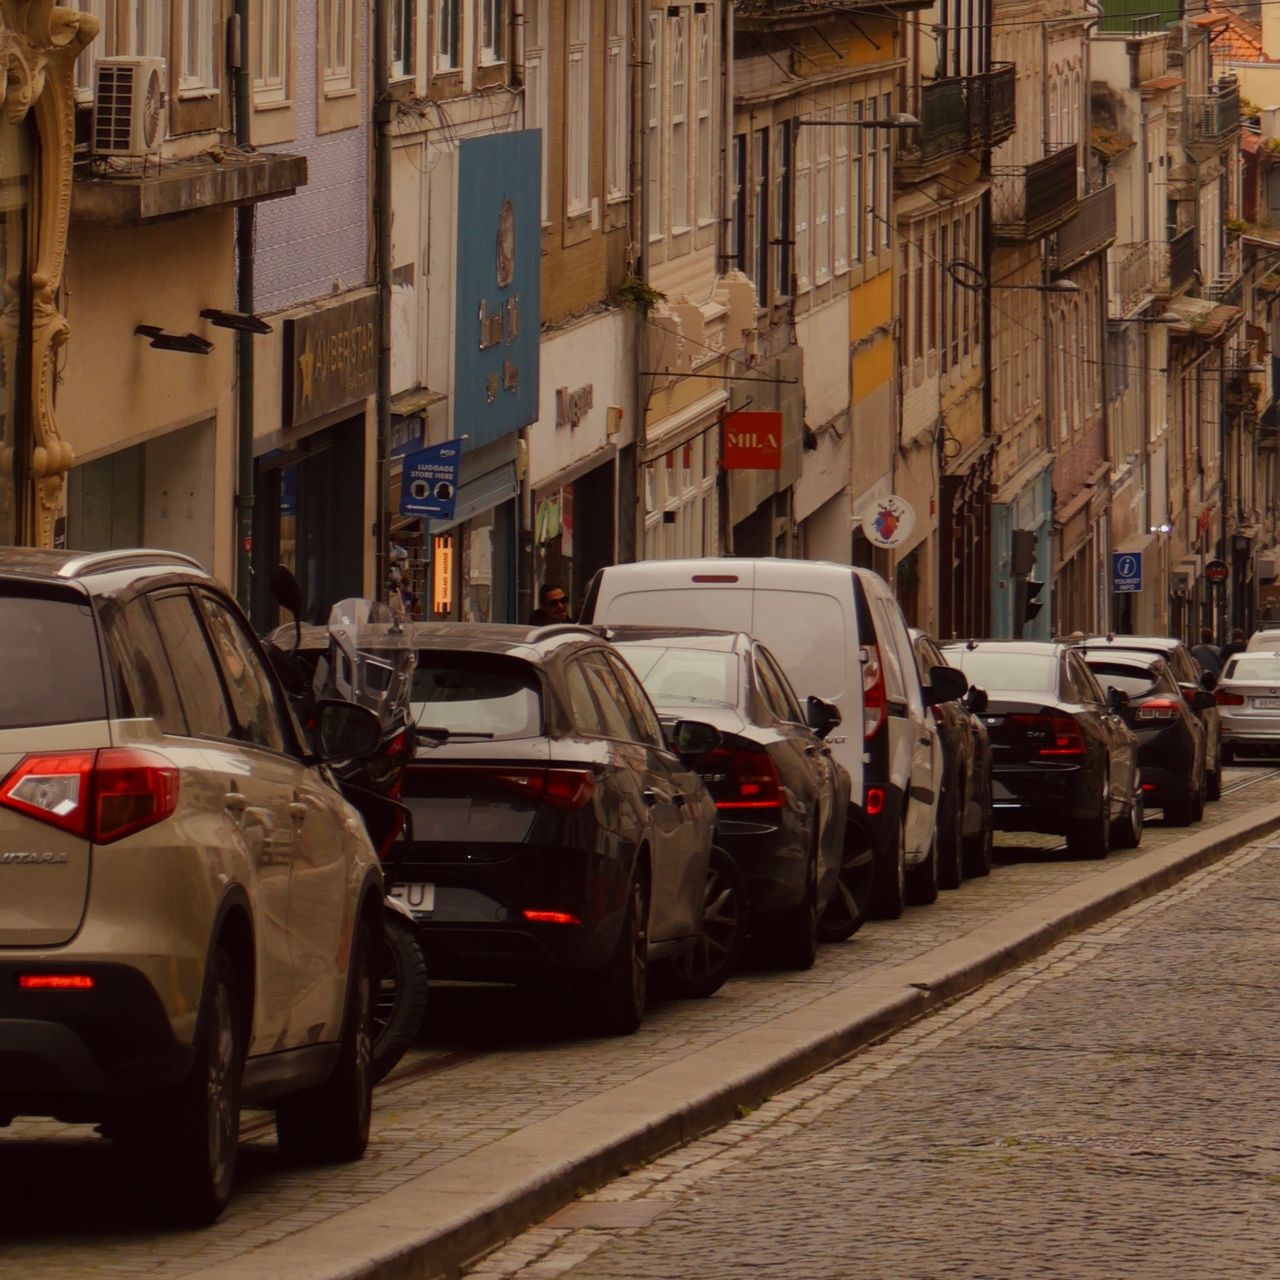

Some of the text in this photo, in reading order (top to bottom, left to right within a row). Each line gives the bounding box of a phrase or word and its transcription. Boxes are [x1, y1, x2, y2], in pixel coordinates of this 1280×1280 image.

[728, 433, 777, 448] MILA
[418, 464, 454, 472] LUGGAGE
[410, 470, 454, 480] STORE HERE
